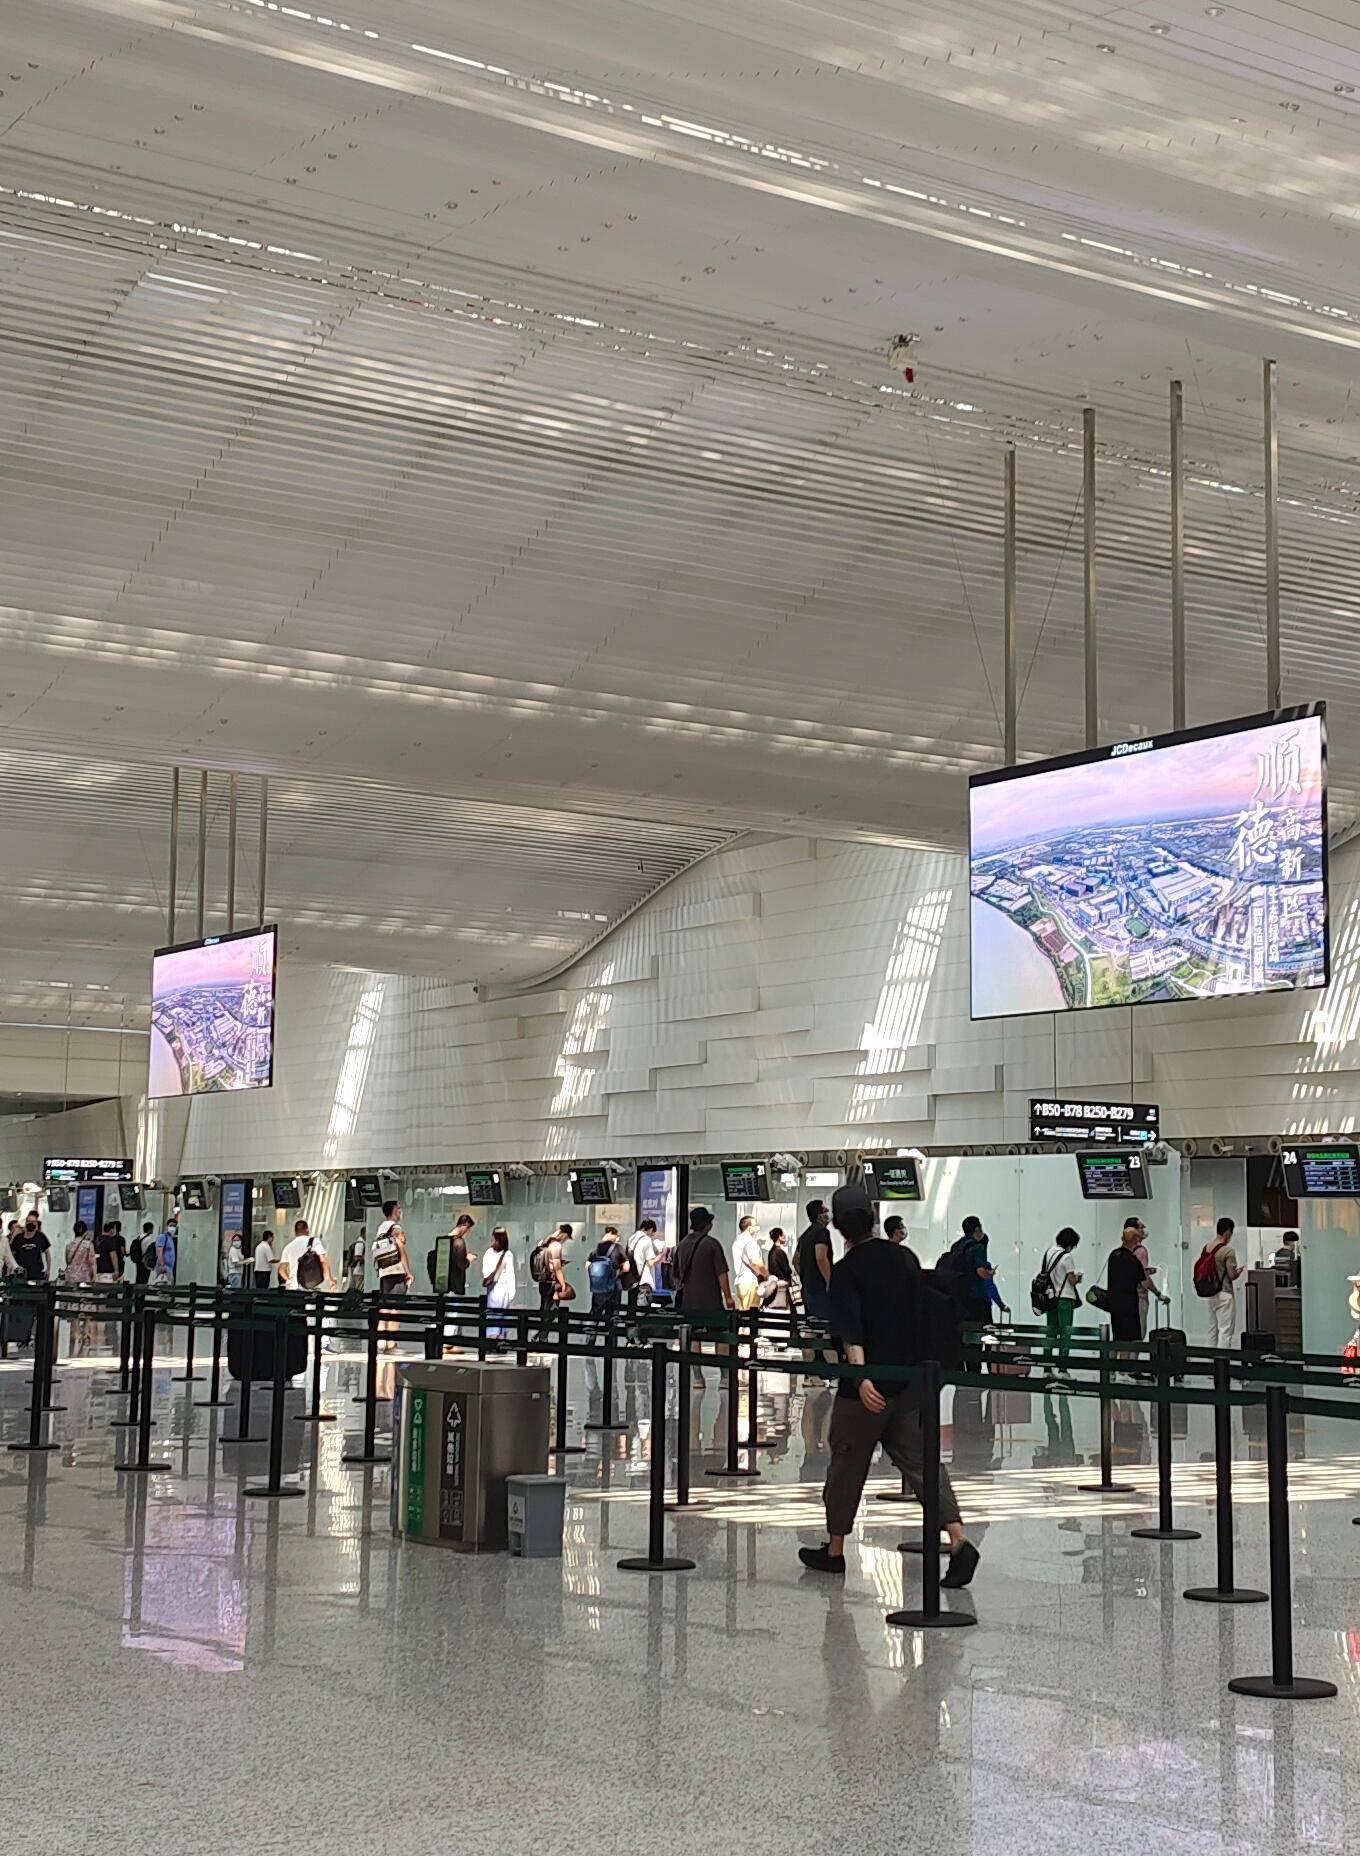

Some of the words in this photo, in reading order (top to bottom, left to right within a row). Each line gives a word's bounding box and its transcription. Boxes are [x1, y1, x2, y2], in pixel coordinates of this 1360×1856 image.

[1111, 740, 1153, 756] JCDecaux
[1042, 1103, 1082, 1117] B50-B78
[1083, 1105, 1134, 1120] B250-B279
[1128, 1156, 1141, 1168] 23
[1283, 1152, 1297, 1165] 24
